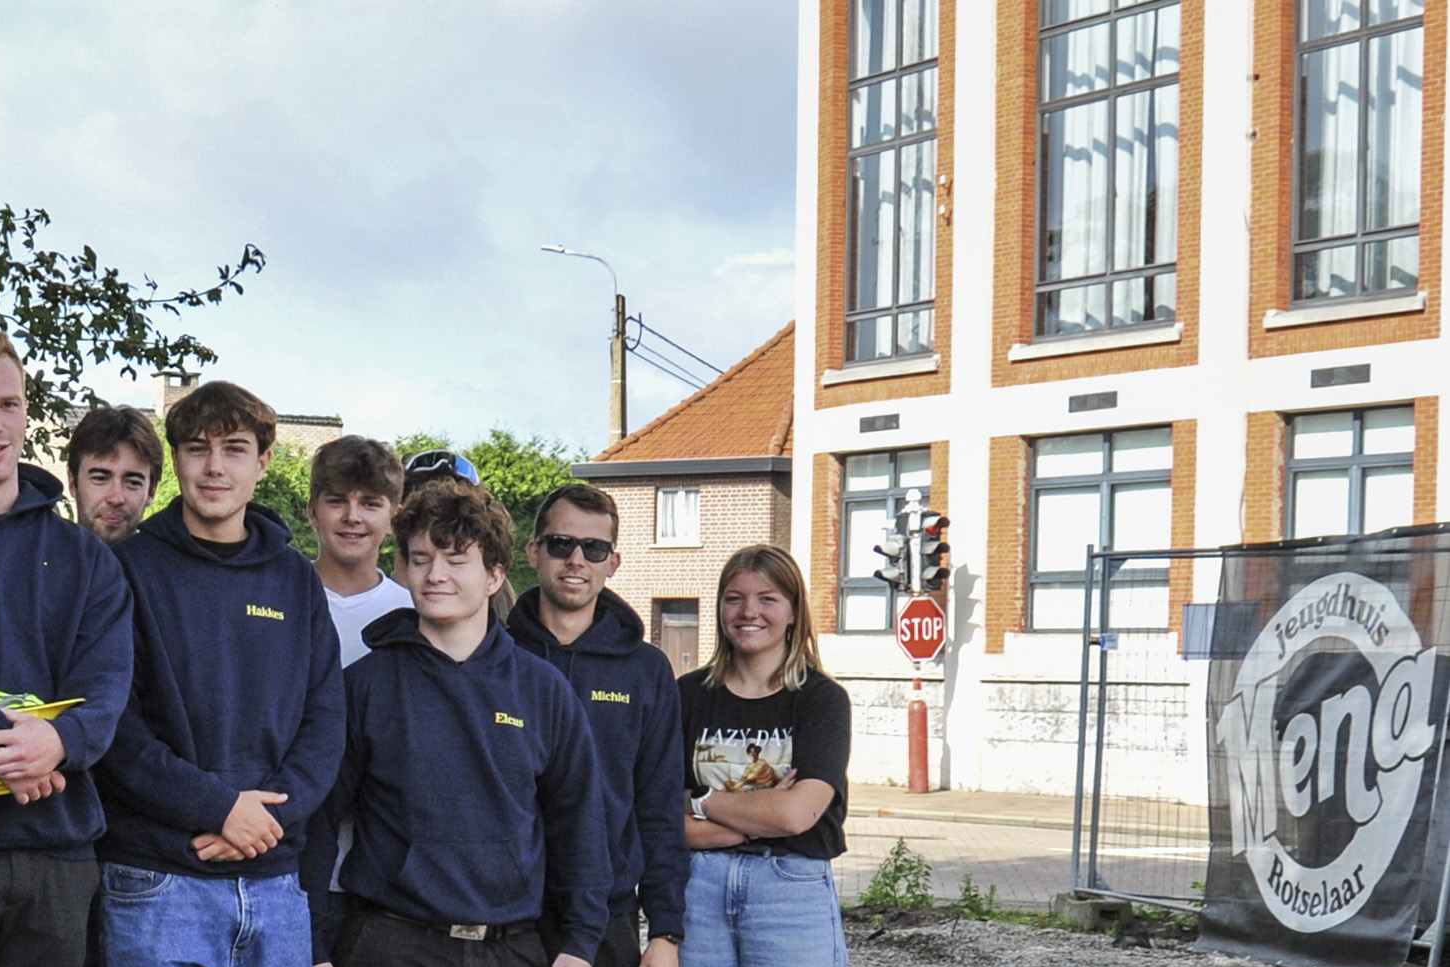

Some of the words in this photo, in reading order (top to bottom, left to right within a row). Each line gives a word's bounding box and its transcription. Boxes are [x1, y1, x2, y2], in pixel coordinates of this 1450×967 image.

[246, 604, 285, 621] Hakkes
[900, 616, 944, 643] STOP
[1274, 583, 1390, 660] jeugdhuis
[699, 727, 752, 747] LAZY
[1215, 645, 1438, 858] Mena
[1266, 852, 1366, 917] Rotselaar
